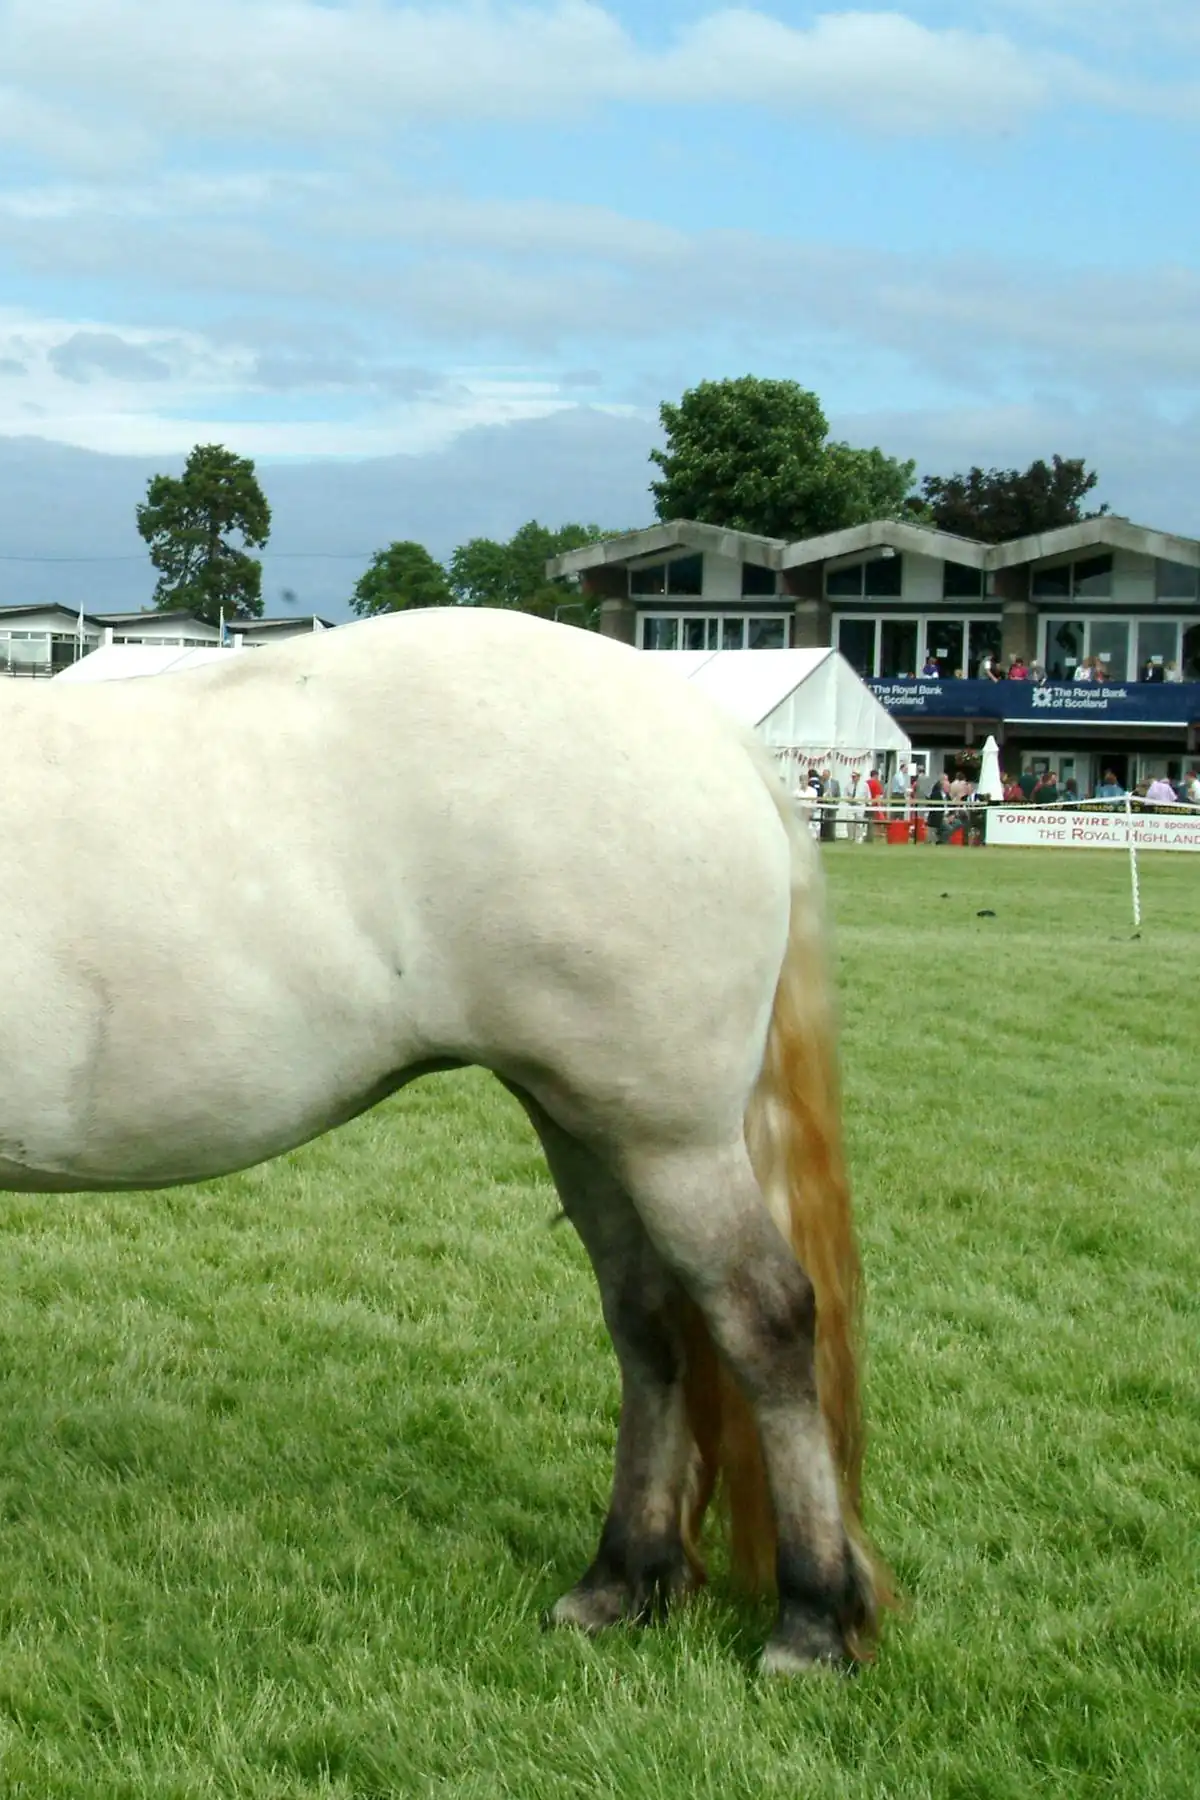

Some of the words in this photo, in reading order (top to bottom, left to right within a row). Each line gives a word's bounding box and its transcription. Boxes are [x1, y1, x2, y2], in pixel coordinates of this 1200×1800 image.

[873, 685, 890, 694] The
[891, 685, 917, 698] Royal
[919, 685, 942, 695] Bank
[1053, 687, 1072, 697] The
[1073, 688, 1100, 701] Royal
[1102, 688, 1127, 697] Bank
[883, 695, 924, 705] Scotland
[1052, 699, 1062, 707] of
[1064, 699, 1108, 708] Scotland
[997, 814, 1067, 825] TORNADO
[1072, 817, 1110, 826] WIRE
[1114, 819, 1145, 828] Prud
[1149, 820, 1160, 829] to
[1038, 829, 1066, 840] THE
[1072, 828, 1120, 841] ROYAL
